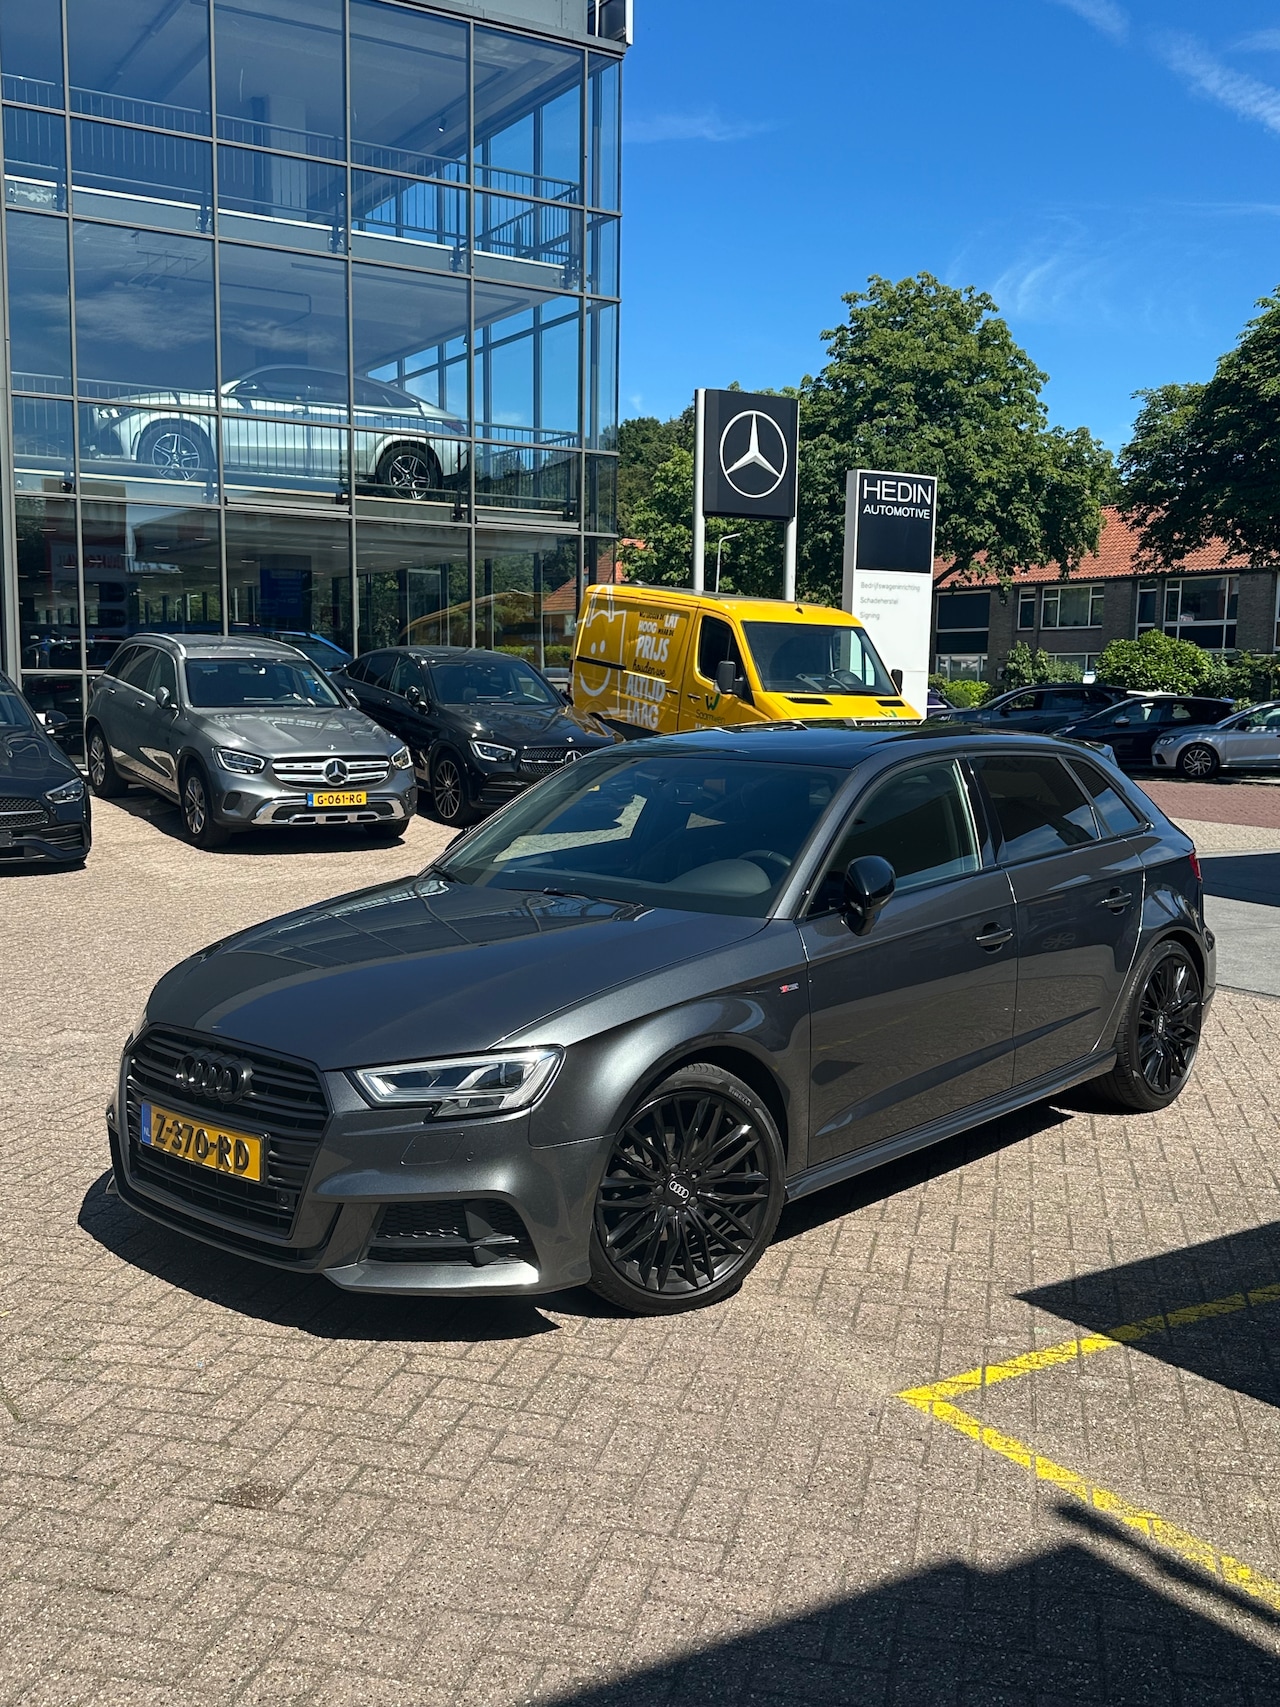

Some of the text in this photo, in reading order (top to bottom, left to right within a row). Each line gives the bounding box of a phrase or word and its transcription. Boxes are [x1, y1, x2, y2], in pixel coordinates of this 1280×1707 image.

[863, 478, 932, 505] HEDIN
[863, 503, 931, 520] AUTOMOTIVE
[860, 596, 899, 605] Schadeherstel
[664, 613, 680, 629] LAT
[859, 611, 881, 621] Signing
[637, 620, 658, 634] HOOG
[635, 635, 670, 663] PRIJS
[625, 674, 667, 702] ALTIJD
[626, 700, 659, 729] LAAG
[317, 793, 363, 805] G-061-RG
[143, 1126, 151, 1138] NL
[155, 1113, 250, 1172] Z-370-RD
